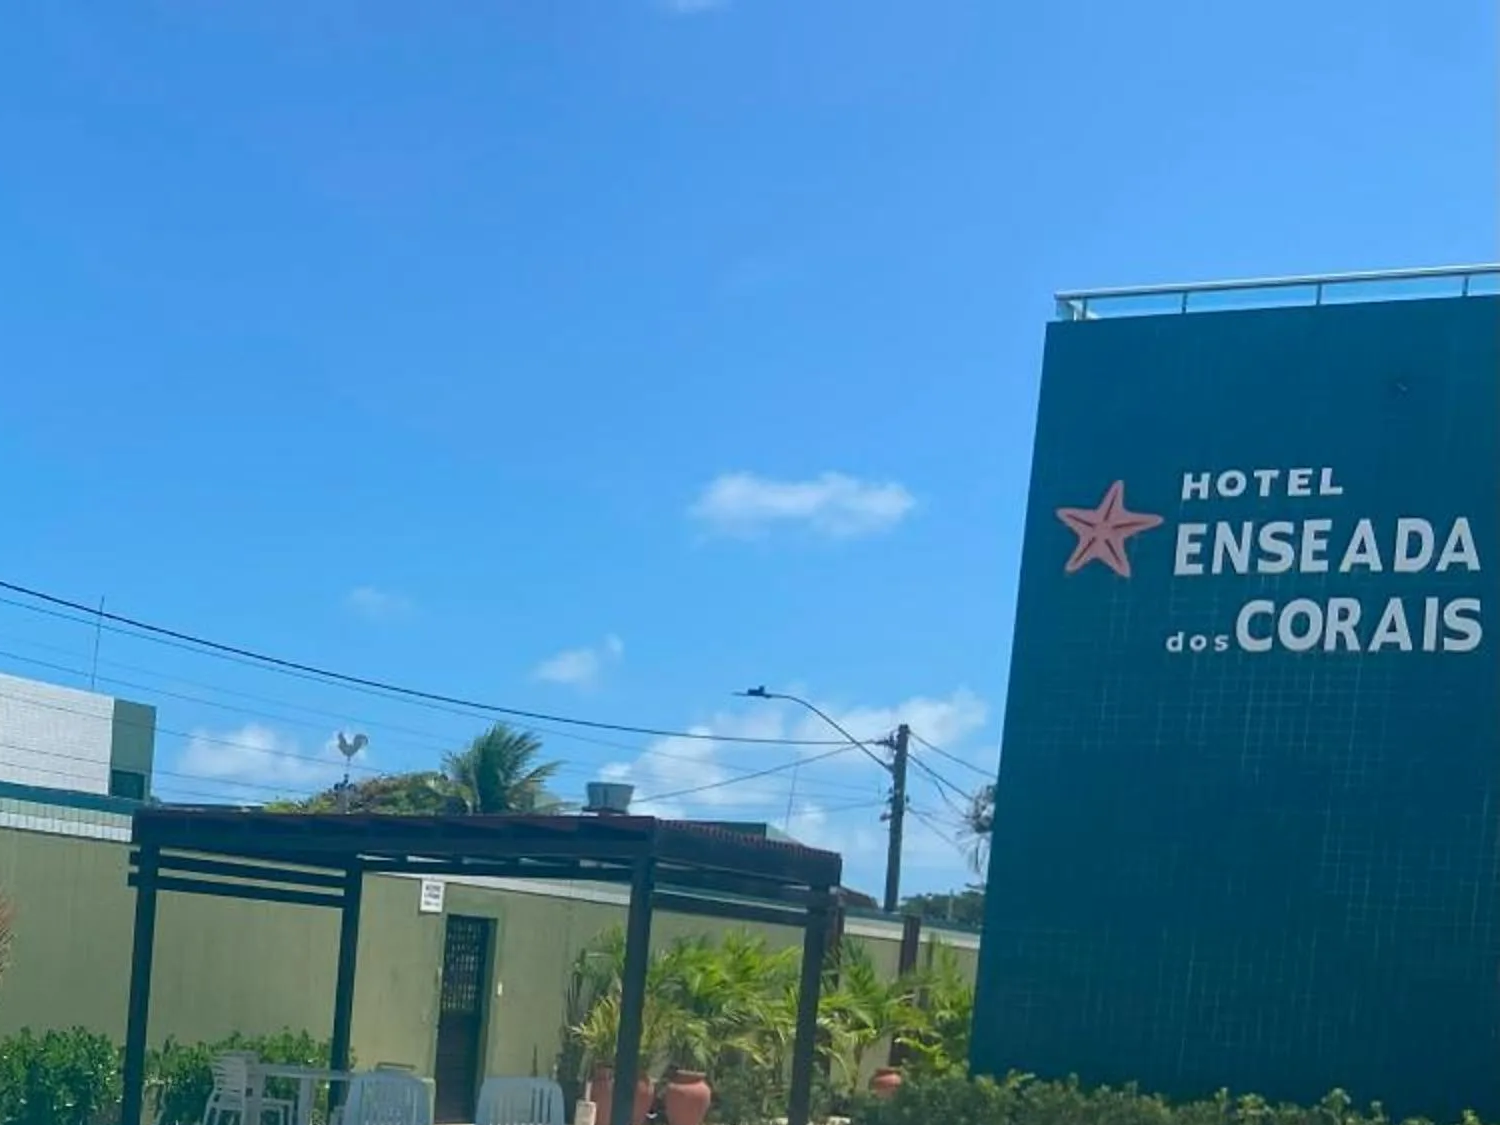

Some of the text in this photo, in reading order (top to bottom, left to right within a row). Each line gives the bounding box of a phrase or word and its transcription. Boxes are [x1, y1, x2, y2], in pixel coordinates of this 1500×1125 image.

[1181, 467, 1344, 500] HOTEL
[1173, 516, 1481, 576] ENSEADA
[1165, 597, 1483, 652] dos CORAIS
